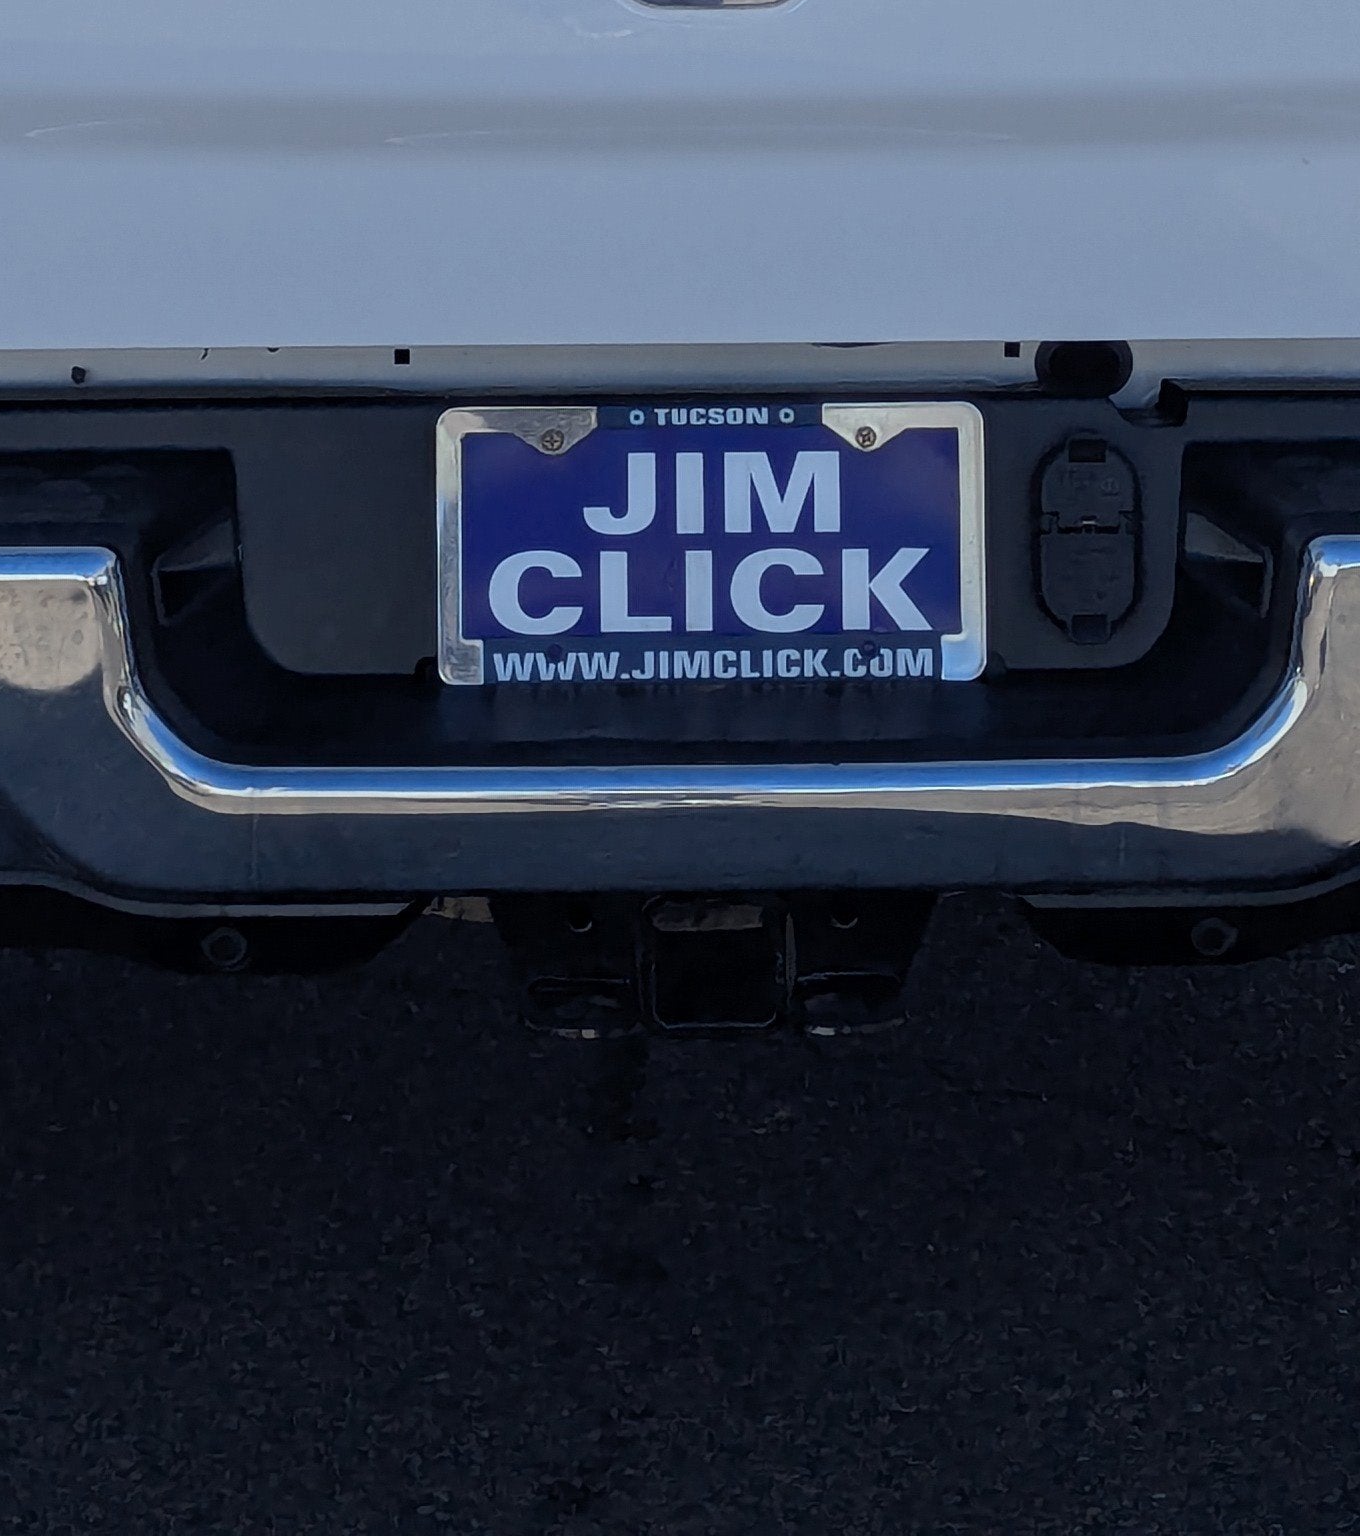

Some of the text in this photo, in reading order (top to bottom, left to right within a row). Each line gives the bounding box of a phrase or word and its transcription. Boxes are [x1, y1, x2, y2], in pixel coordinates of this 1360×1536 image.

[654, 407, 769, 426] TUCSON
[583, 450, 840, 535] JIM
[488, 547, 933, 635] CLICK
[492, 647, 934, 683] WWW.JIMCLICK.COM
